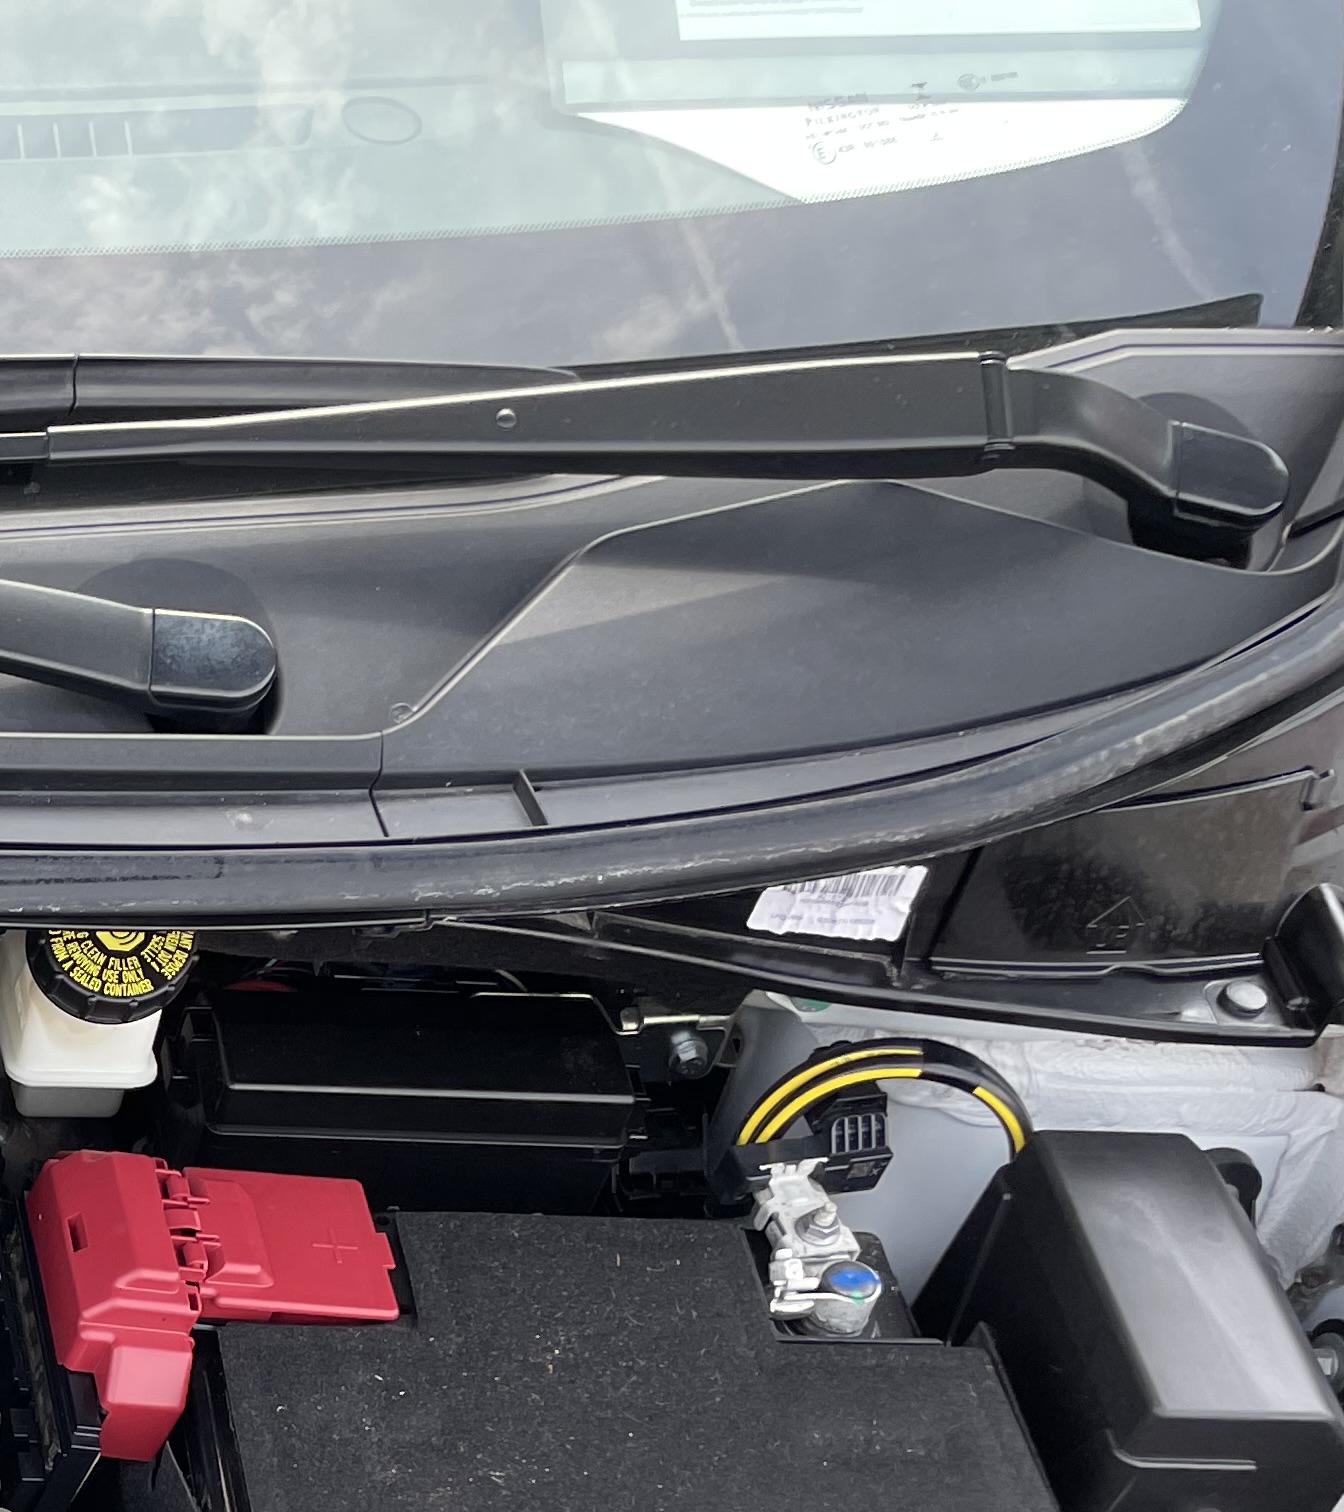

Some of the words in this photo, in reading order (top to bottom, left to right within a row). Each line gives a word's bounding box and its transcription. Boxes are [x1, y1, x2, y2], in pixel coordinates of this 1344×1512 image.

[50, 937, 69, 962] FROM
[62, 960, 74, 971] A
[69, 966, 102, 992] SEALED
[103, 978, 154, 997] CONTAINER
[65, 941, 102, 977] REMOVING
[102, 969, 119, 983] USE
[122, 968, 145, 983] ONLY
[80, 940, 107, 966] CLEAN
[108, 955, 142, 971] FILLER
[160, 949, 189, 980] DEPOSE
